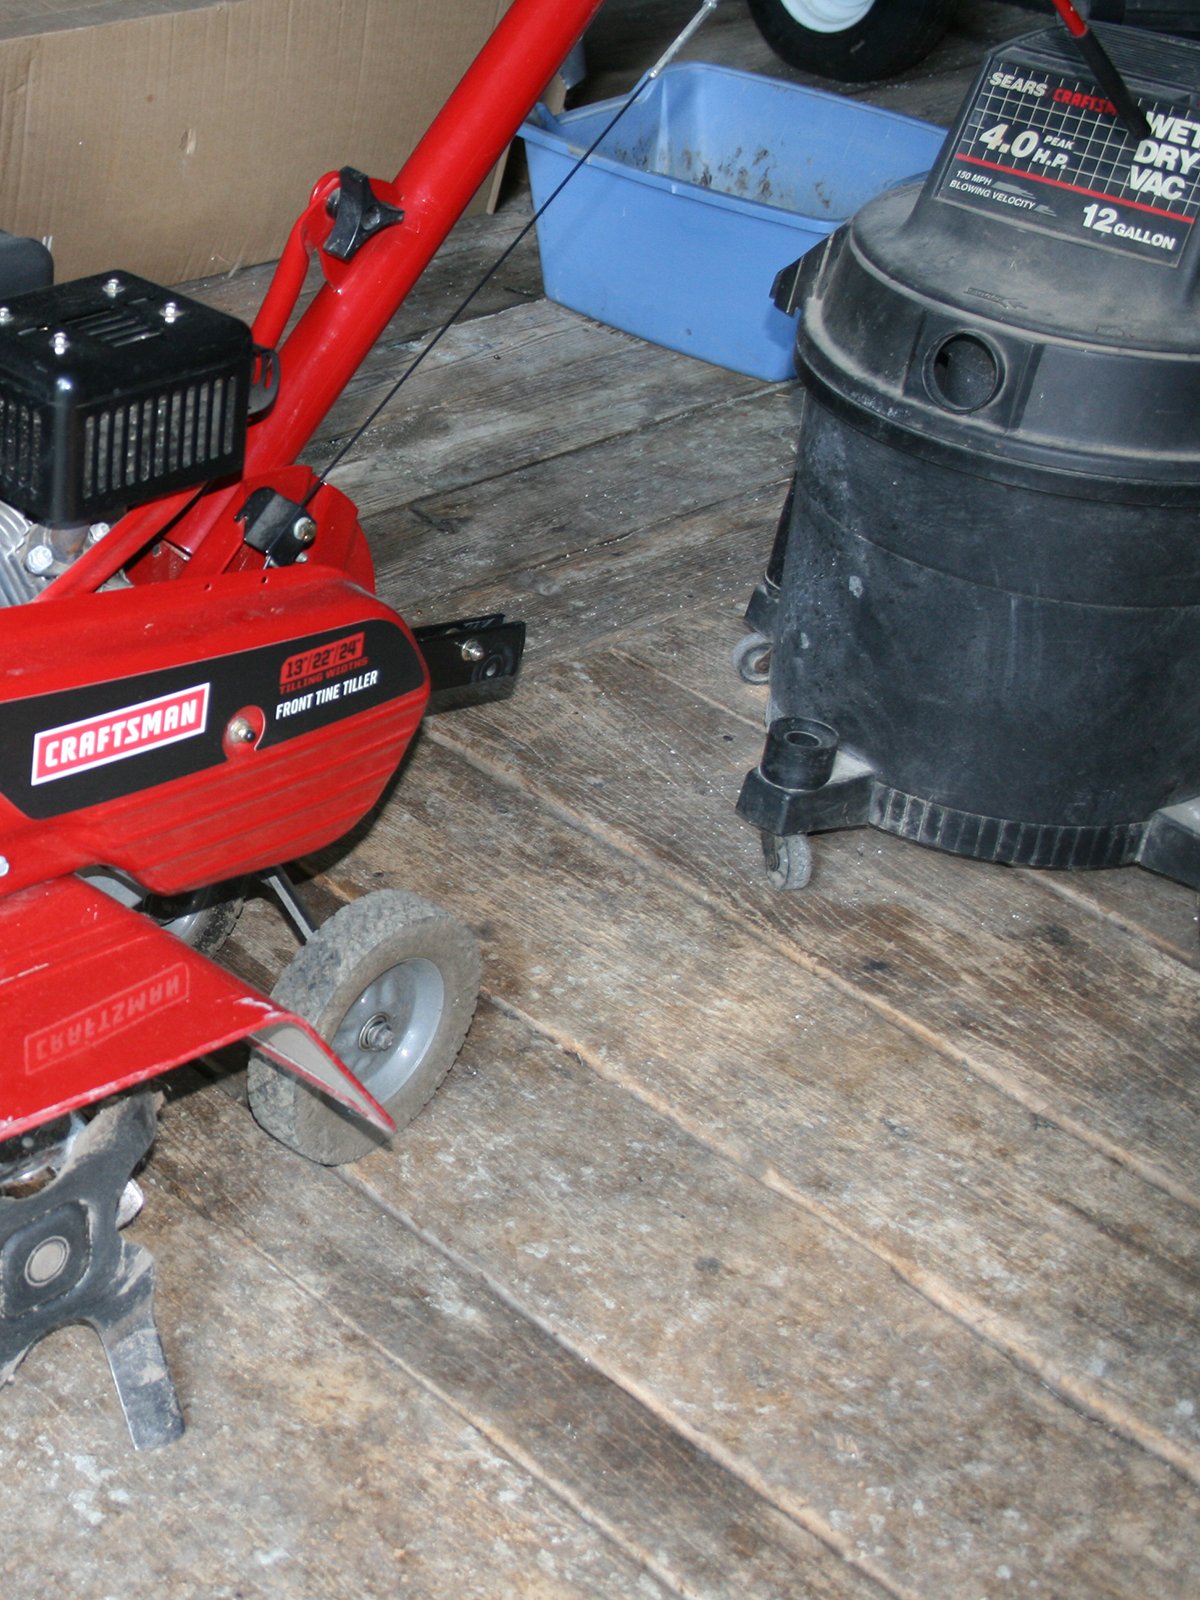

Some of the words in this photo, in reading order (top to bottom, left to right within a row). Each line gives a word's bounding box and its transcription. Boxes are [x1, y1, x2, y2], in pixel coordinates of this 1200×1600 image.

[989, 72, 1048, 97] SEARS
[1053, 87, 1119, 116] CRAFTSM
[979, 123, 1039, 158] 4.0
[1043, 135, 1076, 150] PEAK
[1145, 111, 1200, 149] WET
[1032, 148, 1069, 169] H.P.
[1133, 139, 1200, 175] DRY
[949, 180, 991, 197] BLOWING
[992, 191, 1036, 210] VELOCITY
[956, 170, 972, 180] 150
[971, 173, 993, 186] MPH
[1129, 165, 1185, 201] VAC
[1083, 203, 1118, 234] 12
[1113, 222, 1176, 251] GALLON
[275, 693, 314, 720] FRONT
[315, 683, 341, 706] TINE
[343, 669, 378, 696] TILLER
[280, 672, 323, 696] TILLING
[325, 656, 369, 679] WIDTHS
[45, 699, 197, 768] CRAFTSMAN
